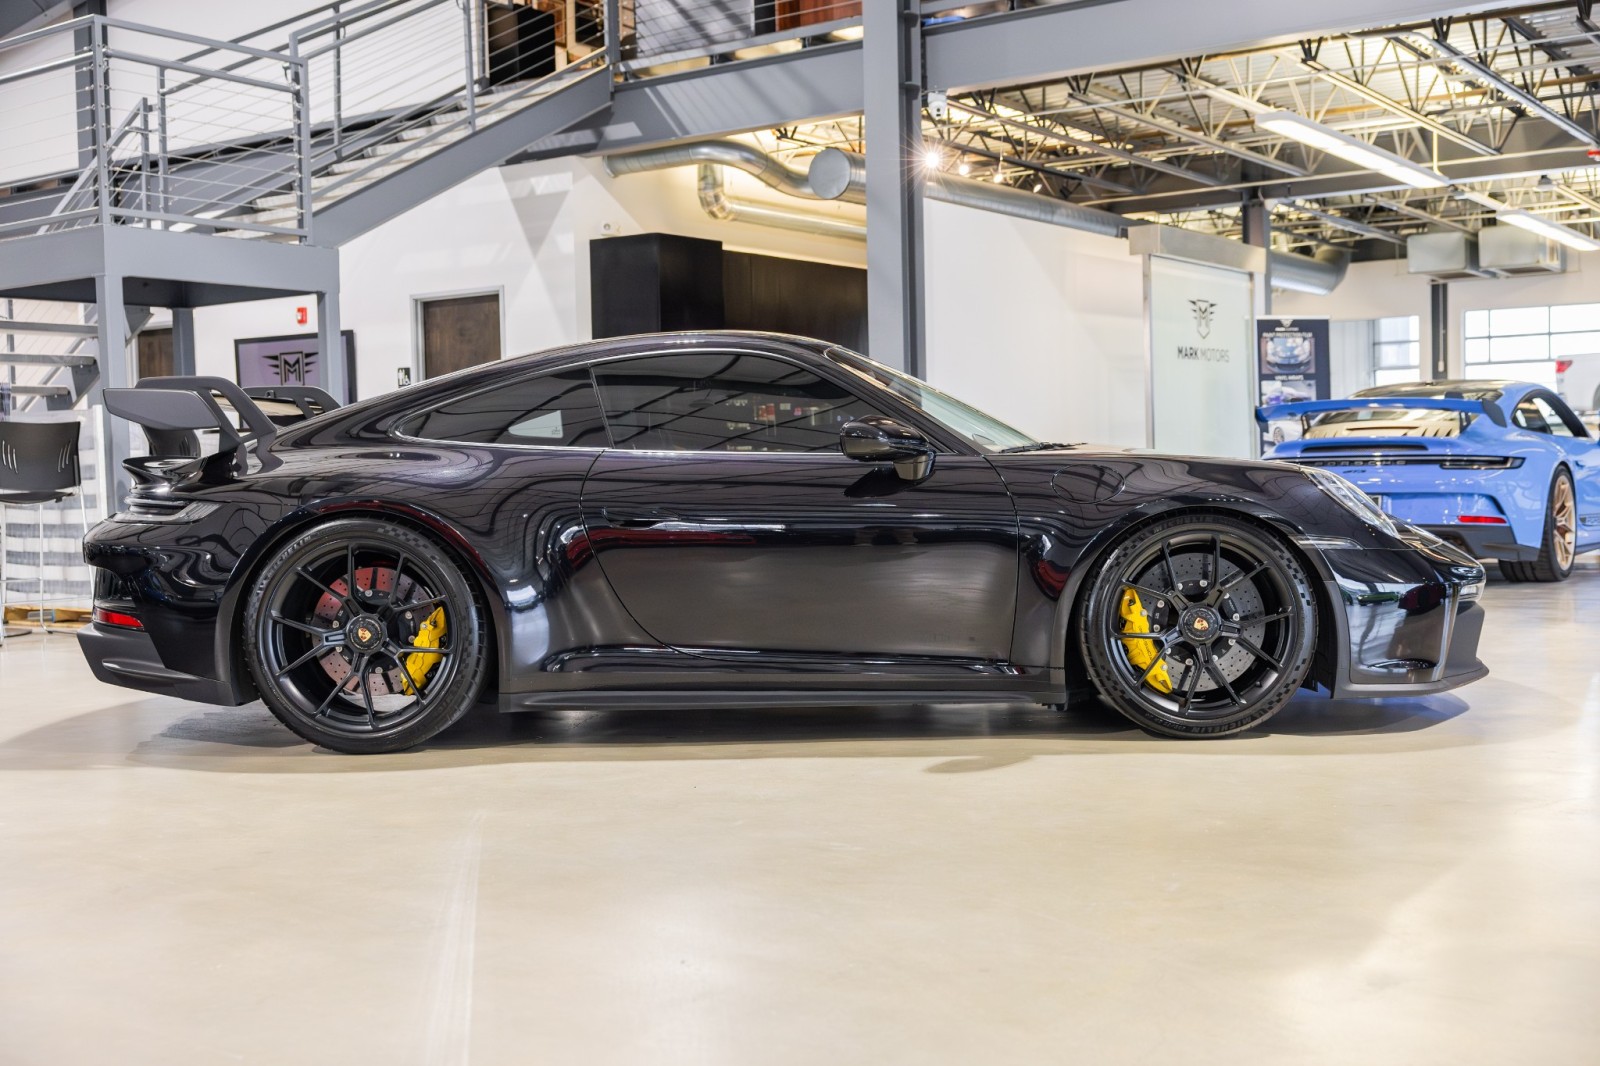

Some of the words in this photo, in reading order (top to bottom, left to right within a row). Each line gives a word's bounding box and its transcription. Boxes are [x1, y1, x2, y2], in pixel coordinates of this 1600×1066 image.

[1177, 346, 1199, 360] MARK
[1201, 348, 1230, 363] MOTORS
[1191, 716, 1252, 734] MICHELIN
